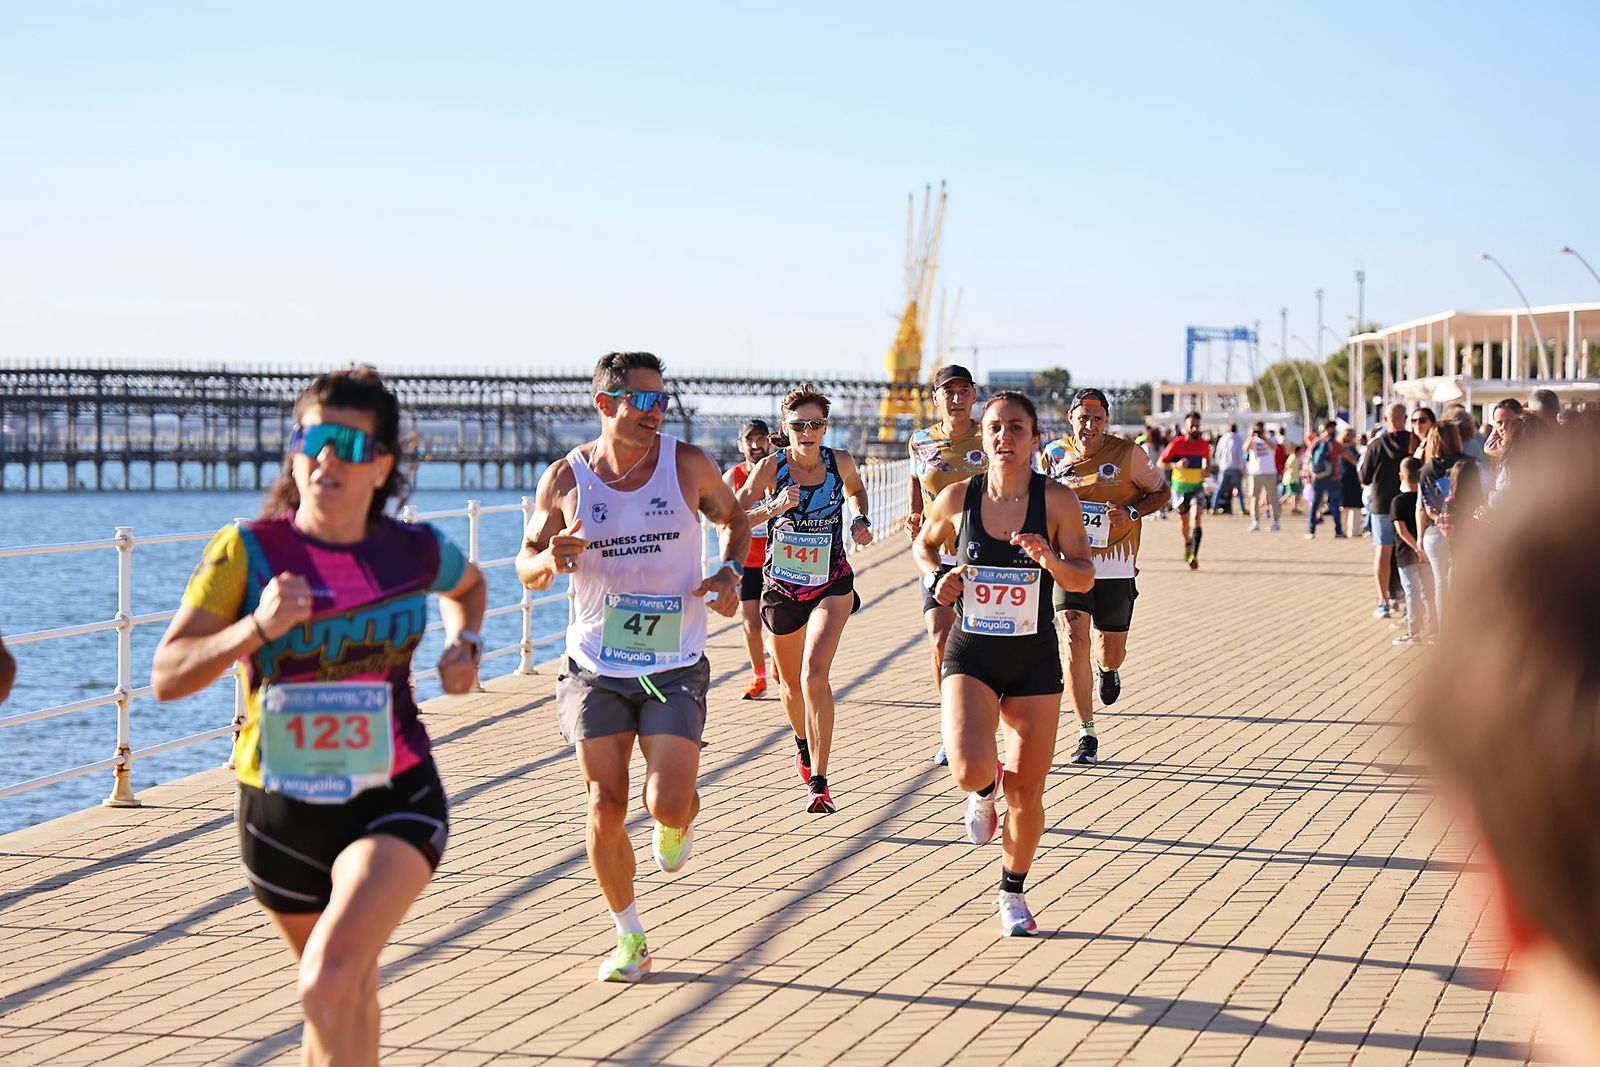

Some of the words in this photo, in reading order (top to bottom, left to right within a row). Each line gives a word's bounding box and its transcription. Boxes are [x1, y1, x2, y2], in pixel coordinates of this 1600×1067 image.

[796, 516, 839, 527] TARTESSOS
[639, 532, 680, 543] CENTER
[602, 544, 662, 558] BELLAVISTA
[783, 544, 819, 563] 141
[975, 584, 1027, 606] 979
[624, 613, 660, 636] 47
[975, 619, 1010, 630] Wayalia
[613, 649, 650, 662] Wayalia
[285, 714, 372, 751] 123
